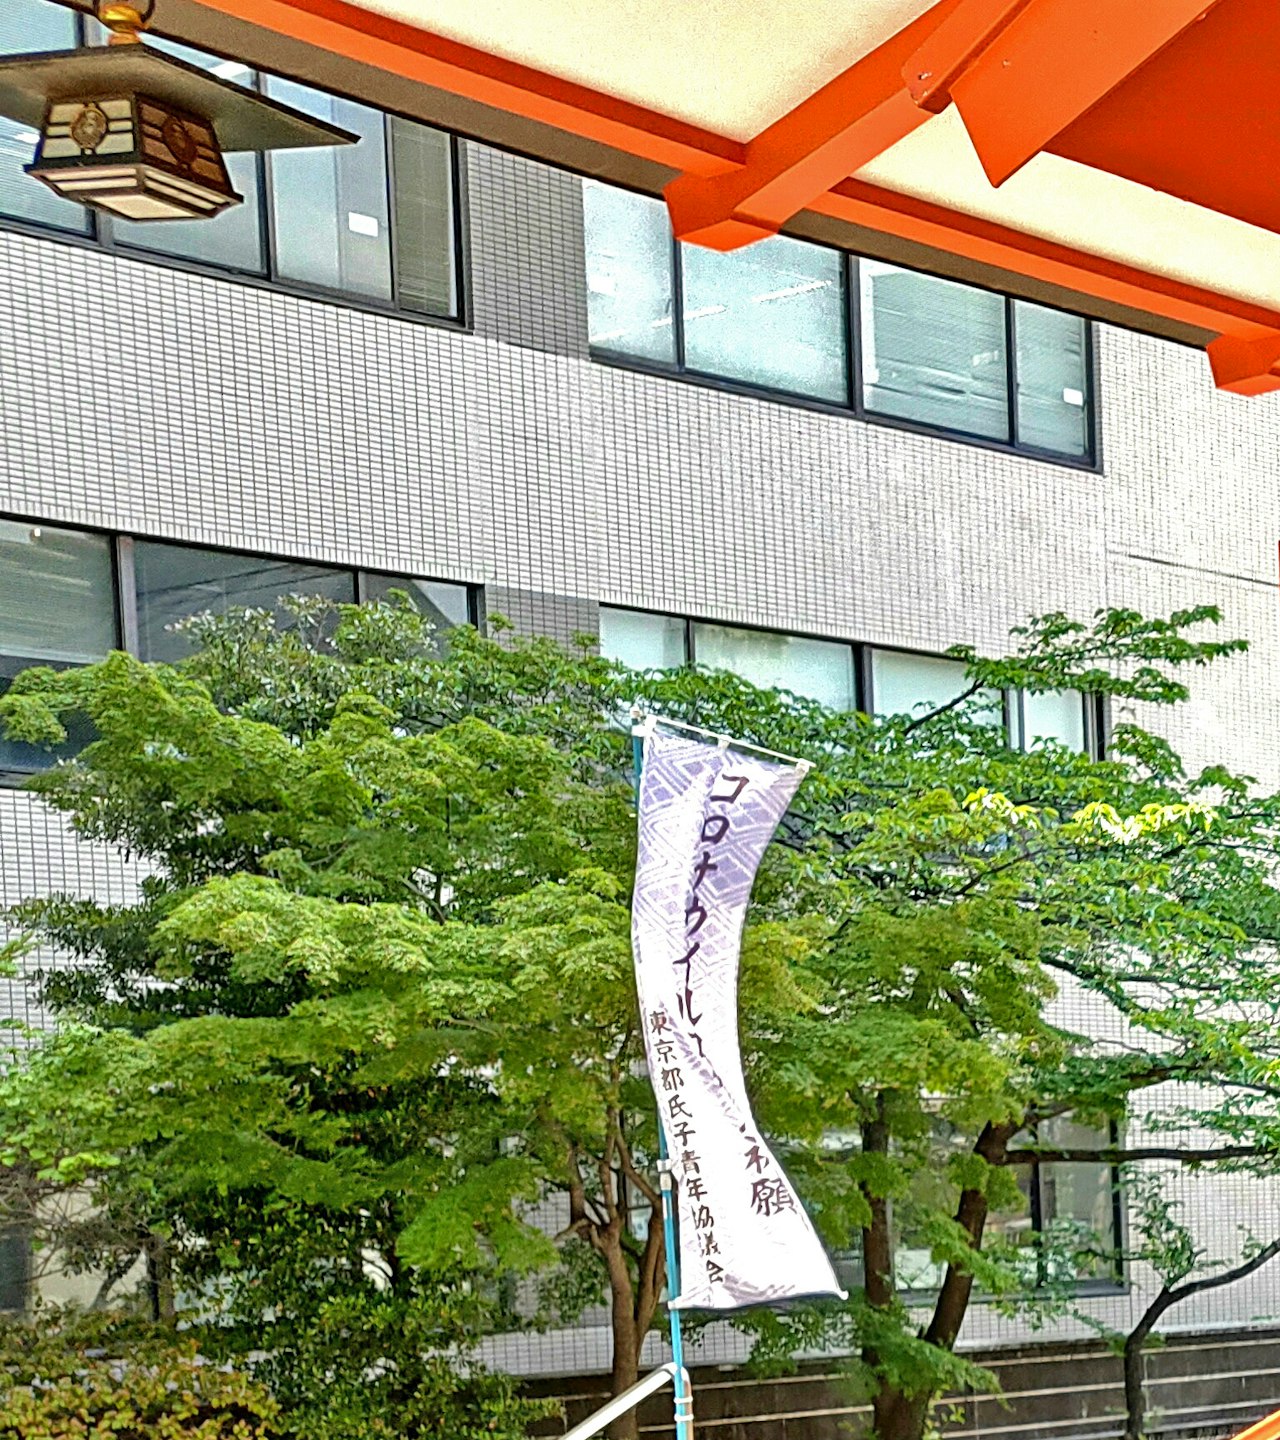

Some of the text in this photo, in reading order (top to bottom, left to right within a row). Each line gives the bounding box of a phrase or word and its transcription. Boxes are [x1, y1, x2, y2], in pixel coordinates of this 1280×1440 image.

[649, 1010, 725, 1284] 東京都氏子青年協議会
[672, 773, 797, 1217] コロナウイル祈願
